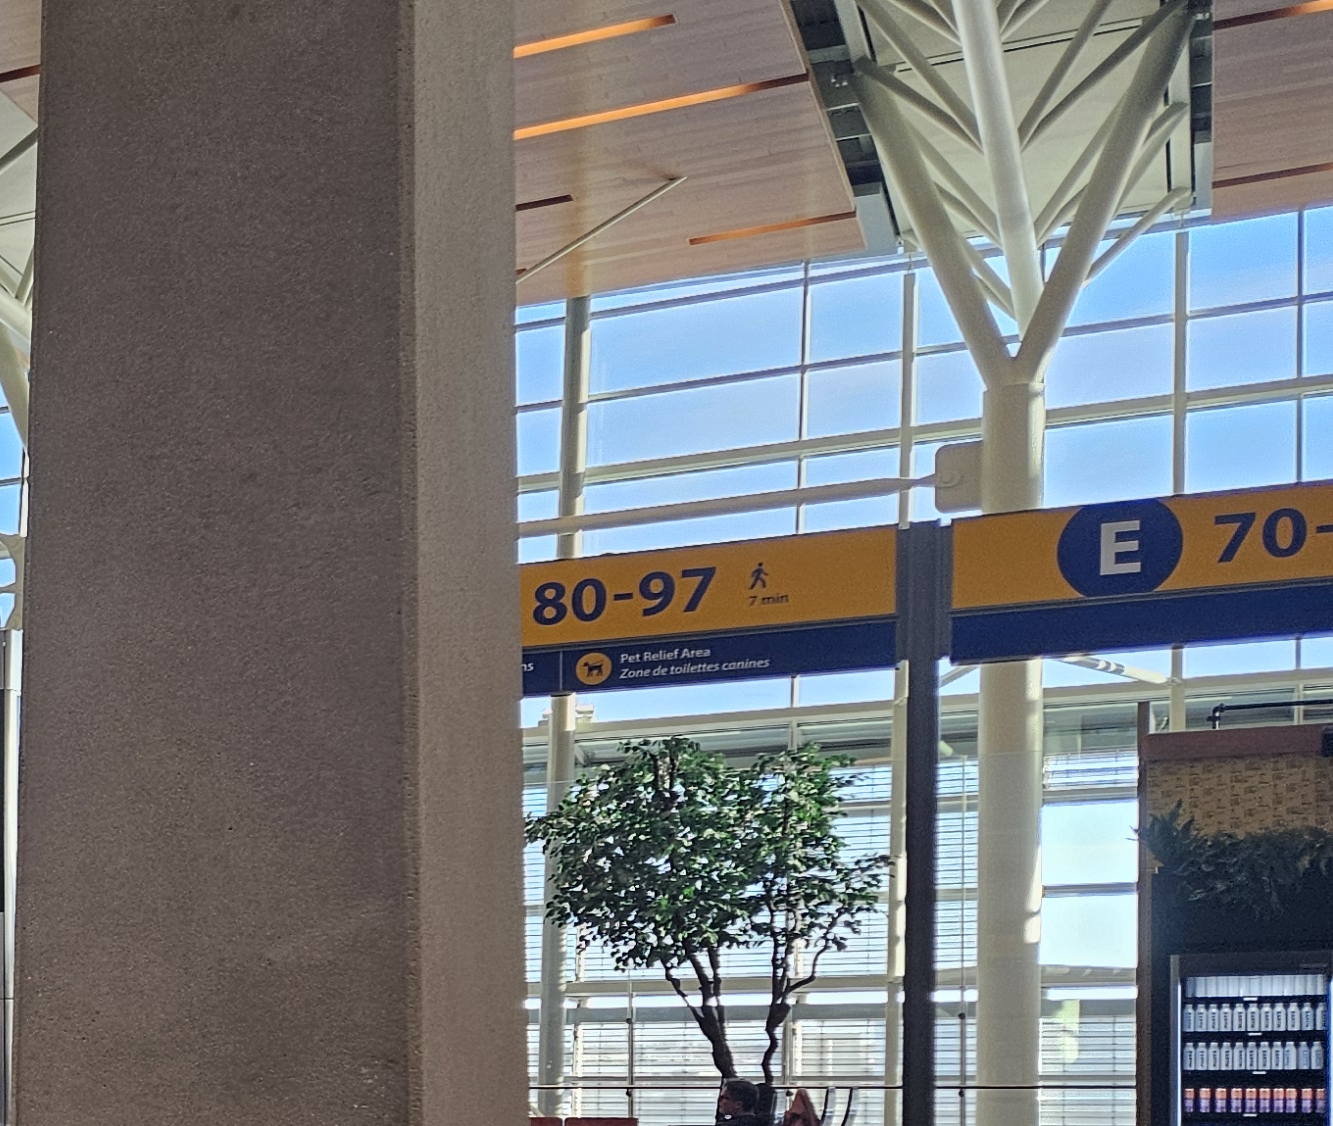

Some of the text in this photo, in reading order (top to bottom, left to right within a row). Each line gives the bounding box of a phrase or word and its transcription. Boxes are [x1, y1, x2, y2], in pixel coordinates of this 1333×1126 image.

[1099, 519, 1142, 576] E
[532, 567, 717, 626] 80-97
[761, 593, 789, 606] min
[620, 647, 711, 664] Pet Relief Area
[619, 657, 770, 680] Zone de toilettes canines
